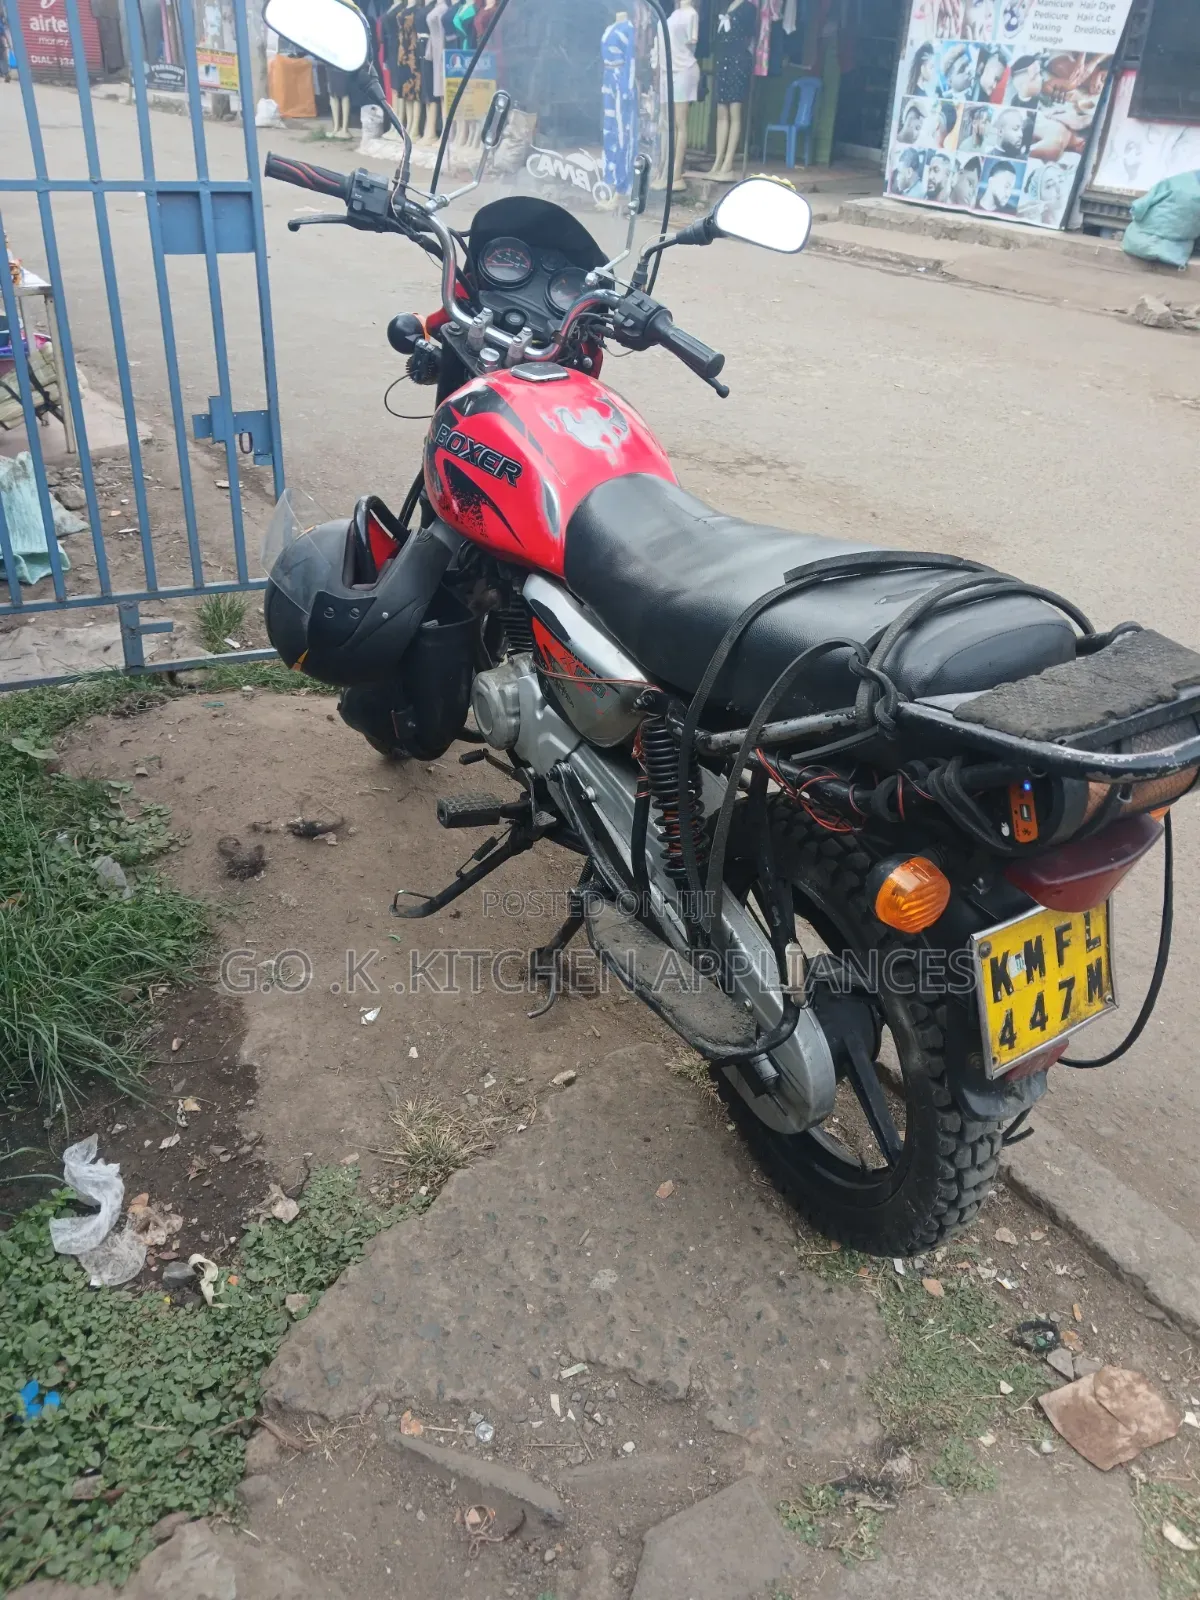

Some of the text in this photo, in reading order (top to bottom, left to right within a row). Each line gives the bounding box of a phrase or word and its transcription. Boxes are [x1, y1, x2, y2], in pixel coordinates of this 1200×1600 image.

[1080, 1, 1116, 12] Hair Dye
[1034, 10, 1069, 20] Pedicure
[1077, 13, 1111, 22] Hair Cut
[1032, 22, 1062, 33] Waxing
[1074, 25, 1116, 36] Dredlocks
[435, 423, 523, 488] BOXER
[998, 957, 1104, 1049] 447M
